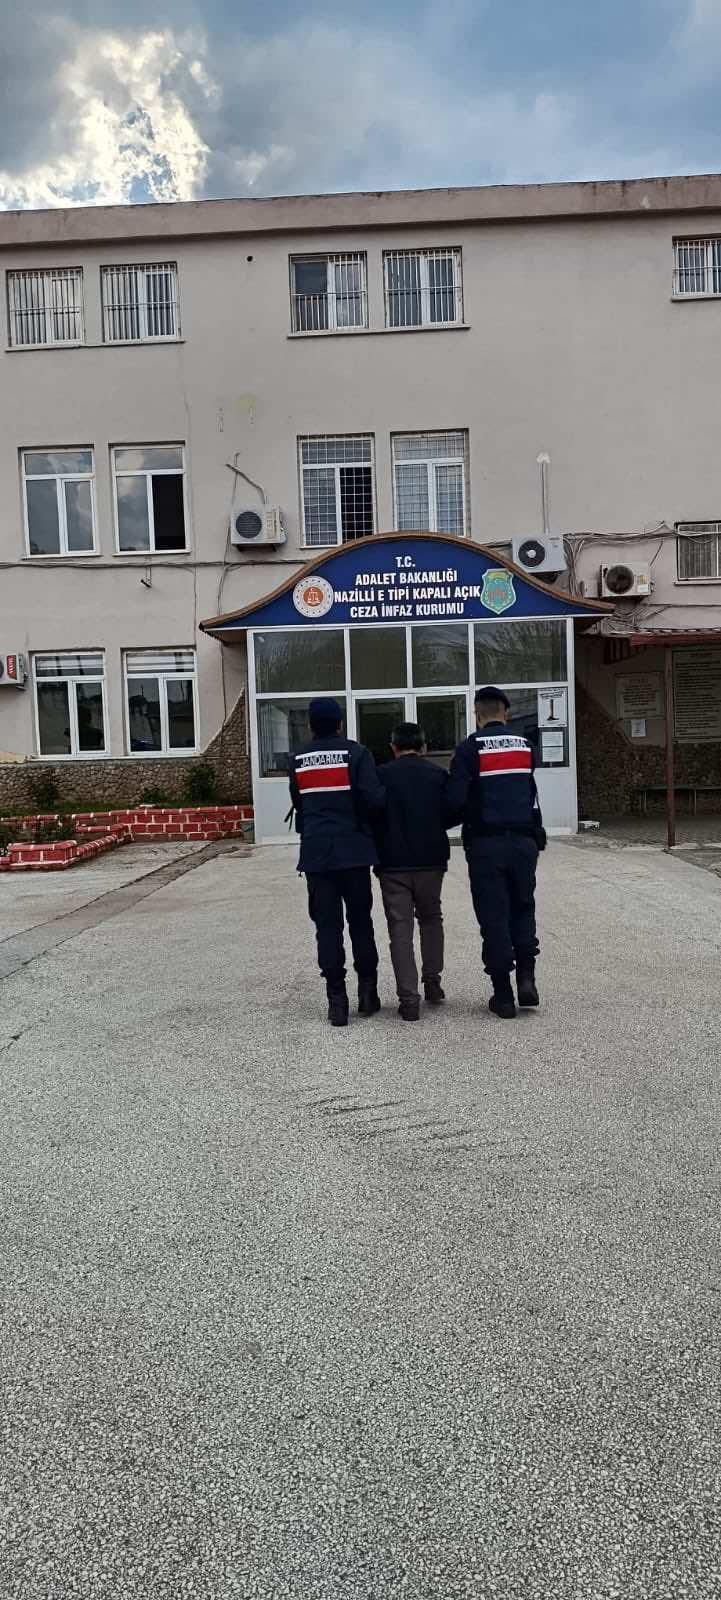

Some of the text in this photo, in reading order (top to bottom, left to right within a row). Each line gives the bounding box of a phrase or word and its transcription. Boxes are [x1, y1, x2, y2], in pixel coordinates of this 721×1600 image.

[395, 556, 416, 568] T.C.
[355, 567, 458, 586] ADALET BAKANLIĞI
[334, 585, 481, 603] NAZİLLİ E TİPİ KAPALI AÇIK
[350, 603, 465, 618] CEZA İNFAZ KURUMU
[483, 739, 527, 750] JANDARMA
[301, 754, 345, 768] JANDARMA
